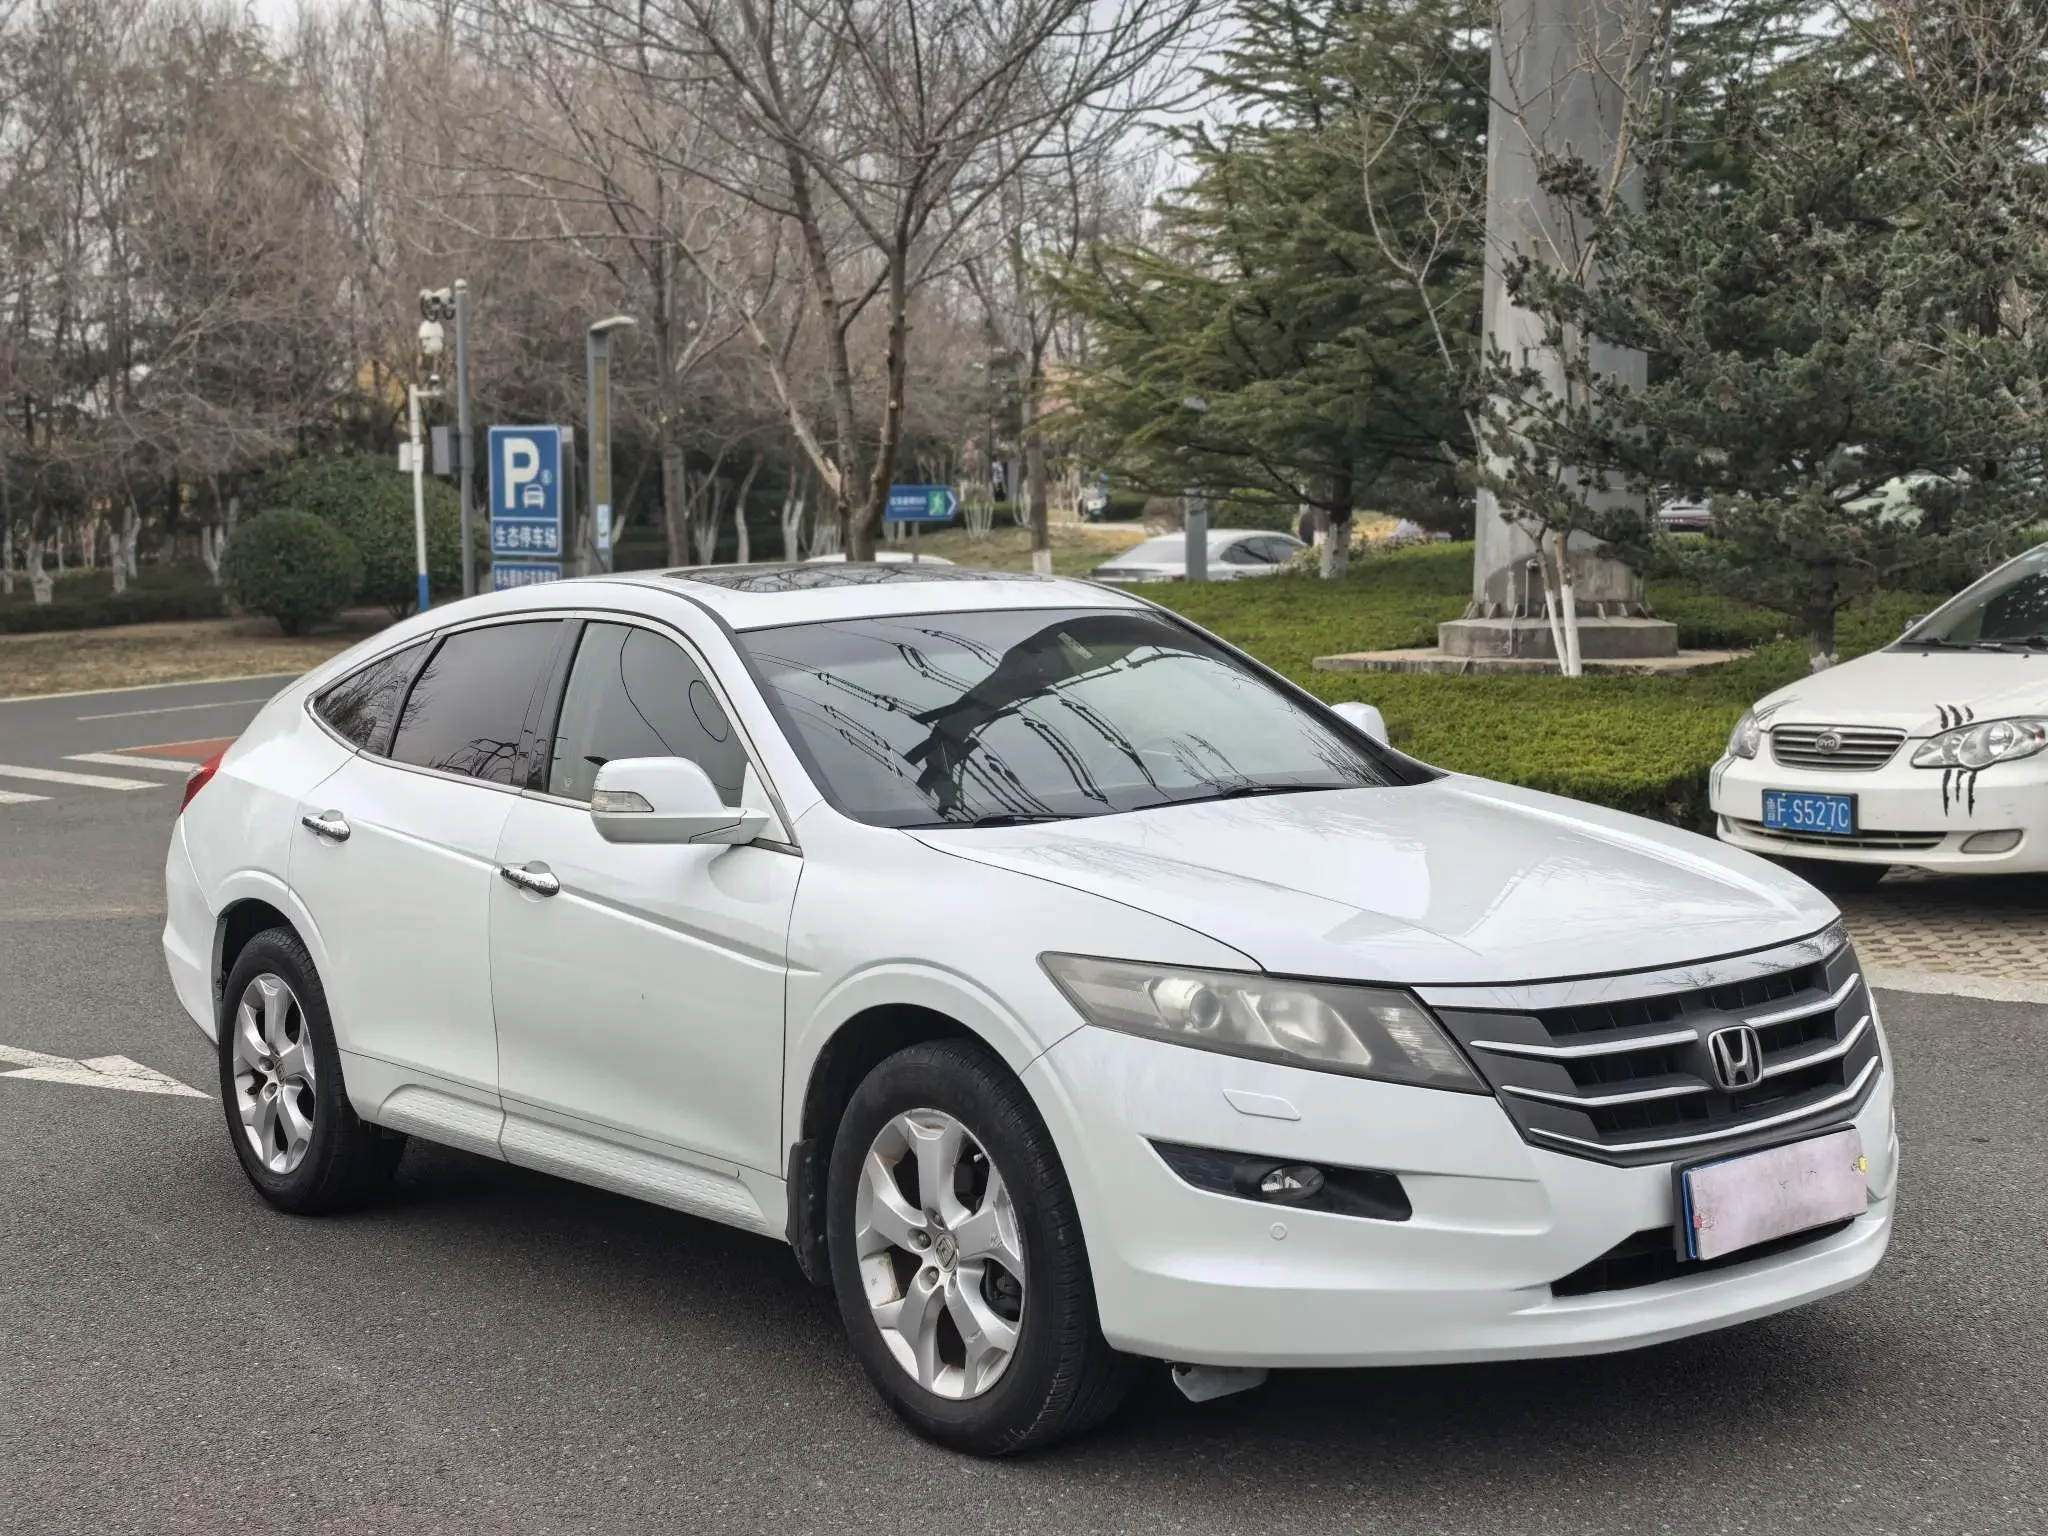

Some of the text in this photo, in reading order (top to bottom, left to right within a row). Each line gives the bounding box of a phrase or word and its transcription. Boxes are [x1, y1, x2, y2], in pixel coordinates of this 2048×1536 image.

[503, 437, 540, 509] P
[495, 525, 557, 549] 生态停车场
